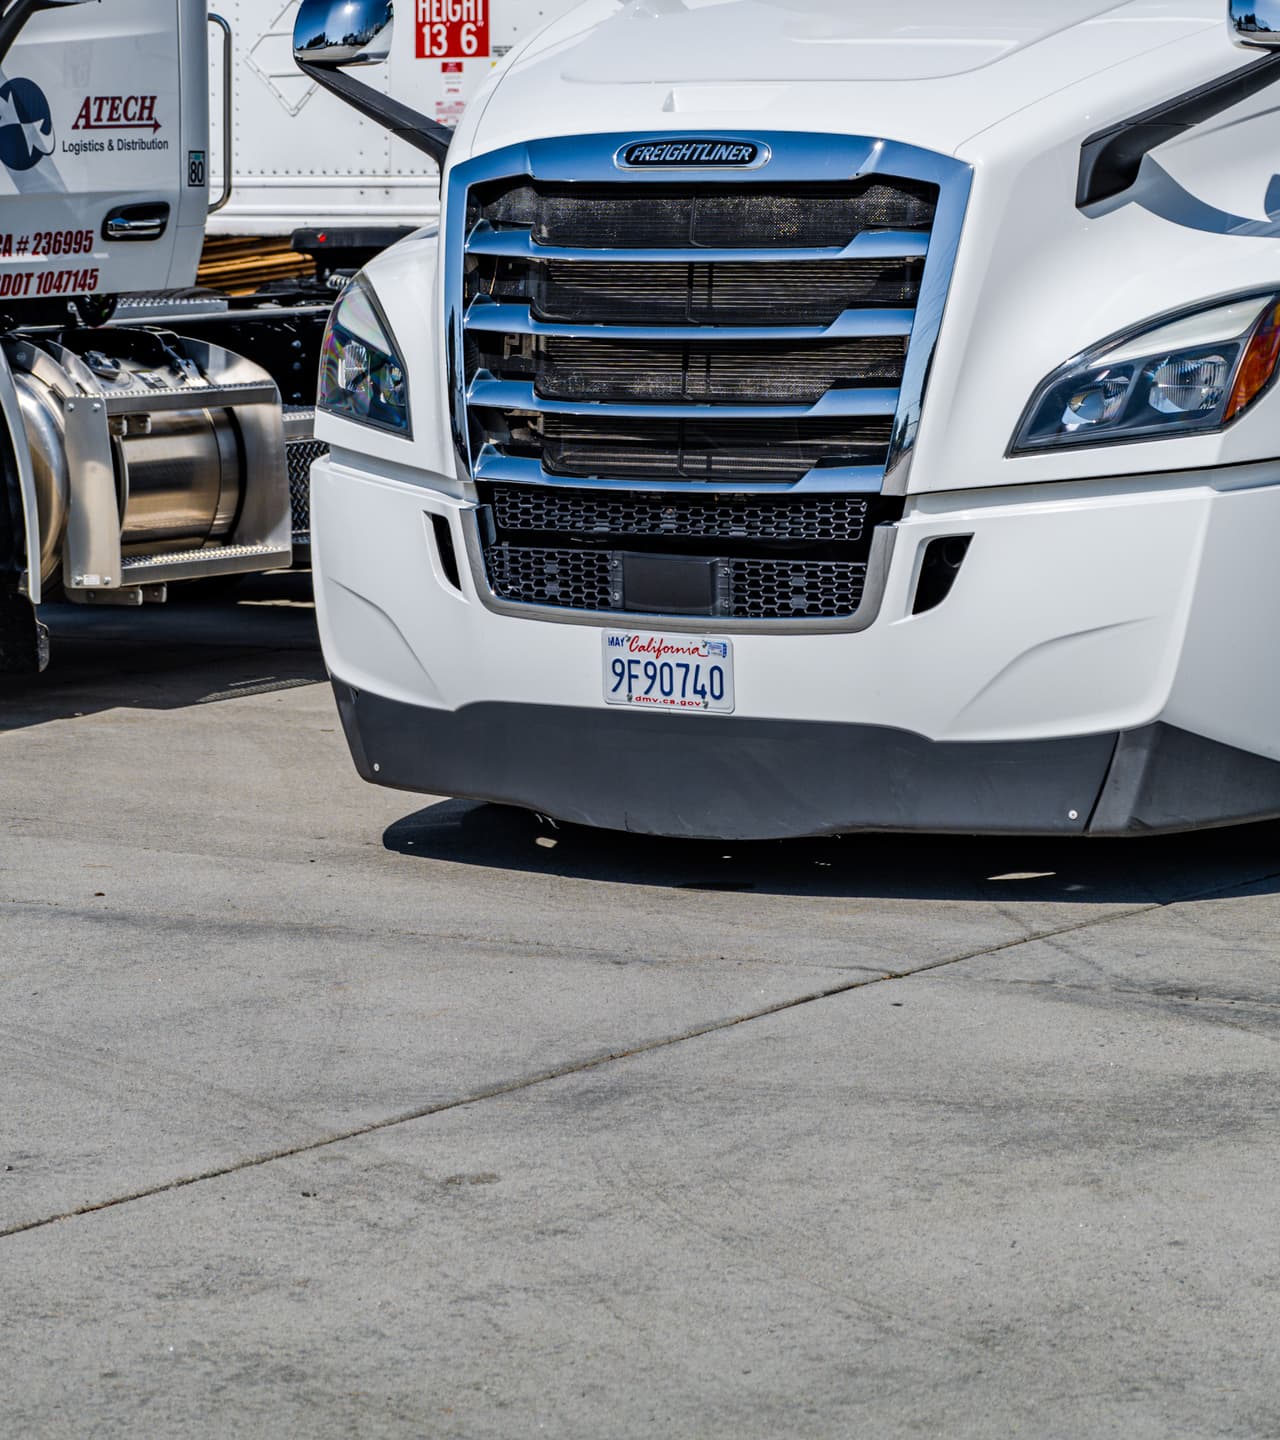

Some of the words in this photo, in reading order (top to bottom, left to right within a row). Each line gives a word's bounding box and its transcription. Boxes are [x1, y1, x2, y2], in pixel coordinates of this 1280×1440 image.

[71, 95, 158, 130] ATECH
[62, 140, 105, 156] Logistics
[107, 139, 115, 151] &
[117, 138, 168, 152] Distribution
[630, 143, 753, 161] FREIGHTLINER
[190, 161, 203, 183] 80
[16, 235, 29, 257] #
[32, 230, 94, 256] 236995
[36, 268, 99, 295] 1047145
[608, 636, 625, 647] MAY
[628, 635, 709, 659] California
[611, 658, 724, 700] 9F90740
[635, 696, 701, 707] dmv.ca.gov
